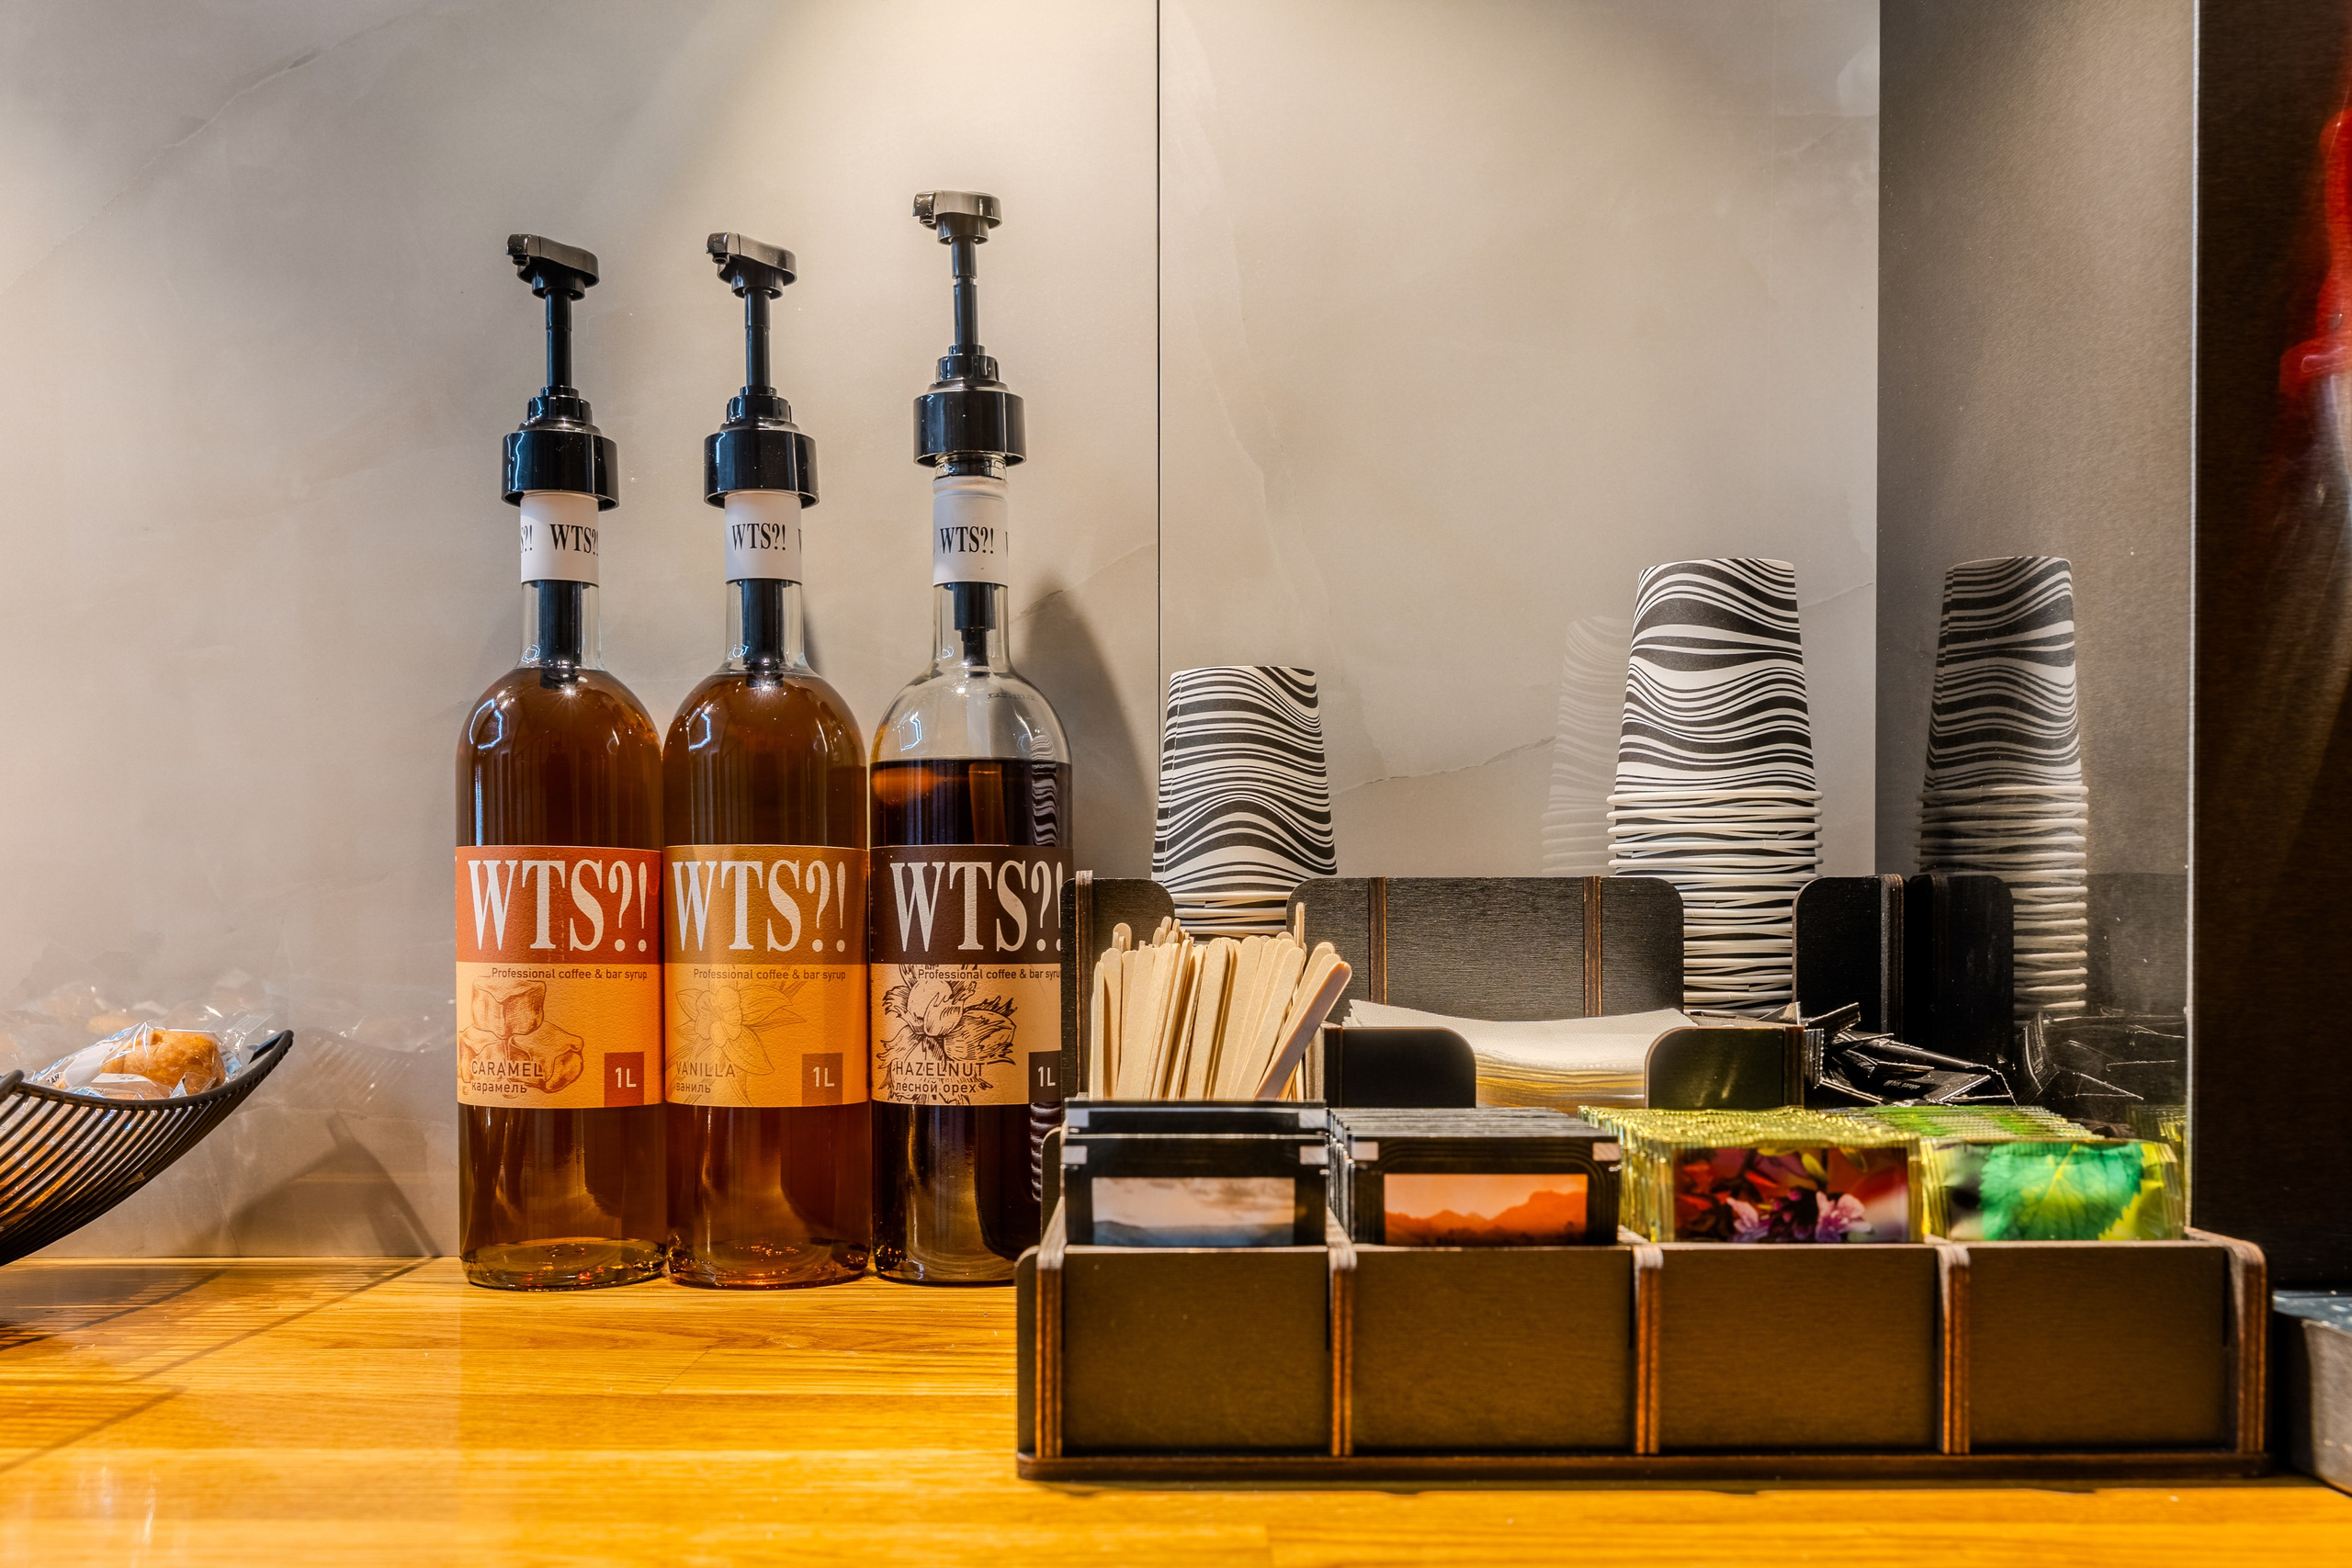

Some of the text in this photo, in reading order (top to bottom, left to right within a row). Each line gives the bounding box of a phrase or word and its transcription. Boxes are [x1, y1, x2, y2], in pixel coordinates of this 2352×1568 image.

[549, 524, 599, 557] WTS?!
[732, 523, 786, 551] WTS?!
[940, 525, 994, 554] WTS?!
[468, 859, 648, 952] WTS?!
[673, 859, 846, 953] WTS?!
[492, 967, 648, 981] Professional coffee & bar syrup
[694, 968, 846, 981] Professional coffee & bar syrup
[919, 969, 1060, 980] Professional coffee & bar syru
[471, 1060, 543, 1077] CARAMEL
[615, 1066, 637, 1088] 1L
[676, 1061, 736, 1077] VANILLA
[813, 1066, 835, 1088] 1L
[896, 1062, 985, 1077] HAZELNUT
[1037, 1066, 1056, 1087] 1L
[471, 1081, 527, 1094] карамель
[676, 1082, 711, 1093] ваниль
[896, 1081, 976, 1096] лесной орех
